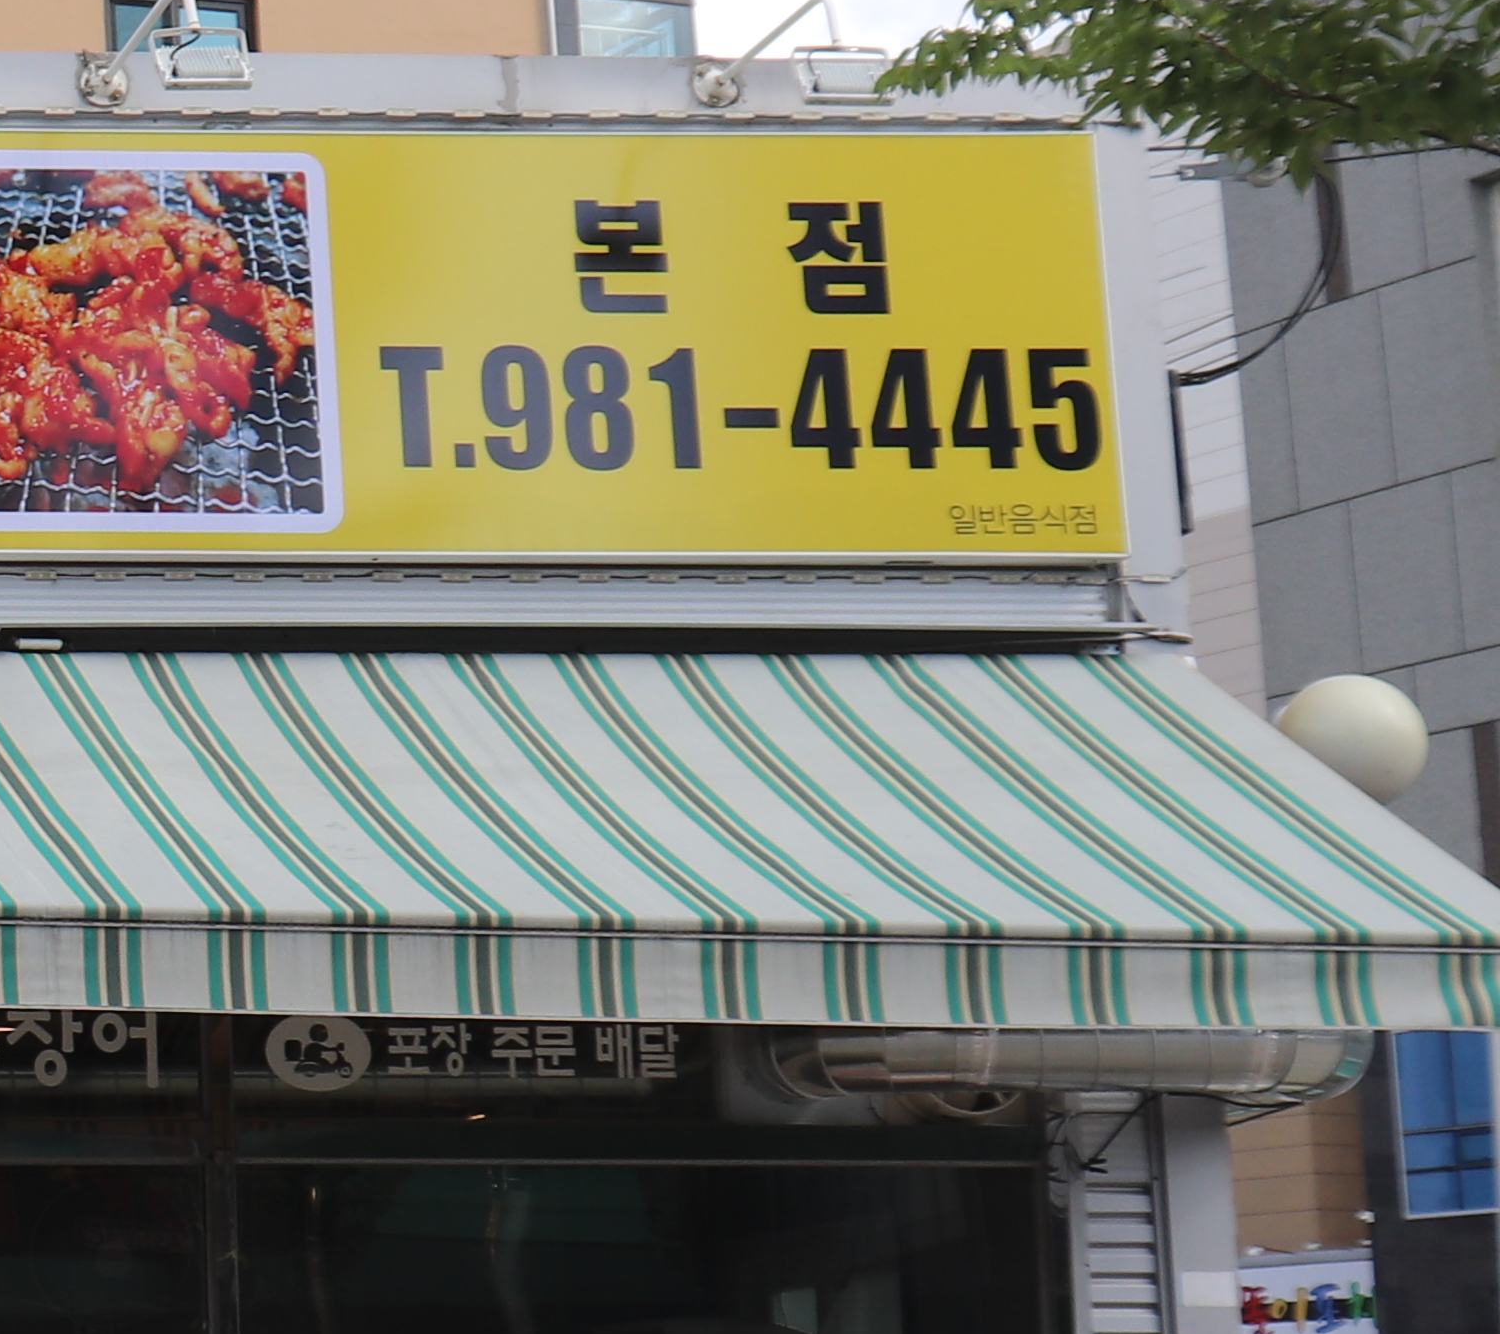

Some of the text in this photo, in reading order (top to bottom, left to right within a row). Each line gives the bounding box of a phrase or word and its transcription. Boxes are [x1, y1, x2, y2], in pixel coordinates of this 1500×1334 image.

[378, 345, 1102, 470] T.981-4445
[949, 503, 1098, 535] 일반음식점
[386, 1023, 680, 1080] 포장 주문 배달
